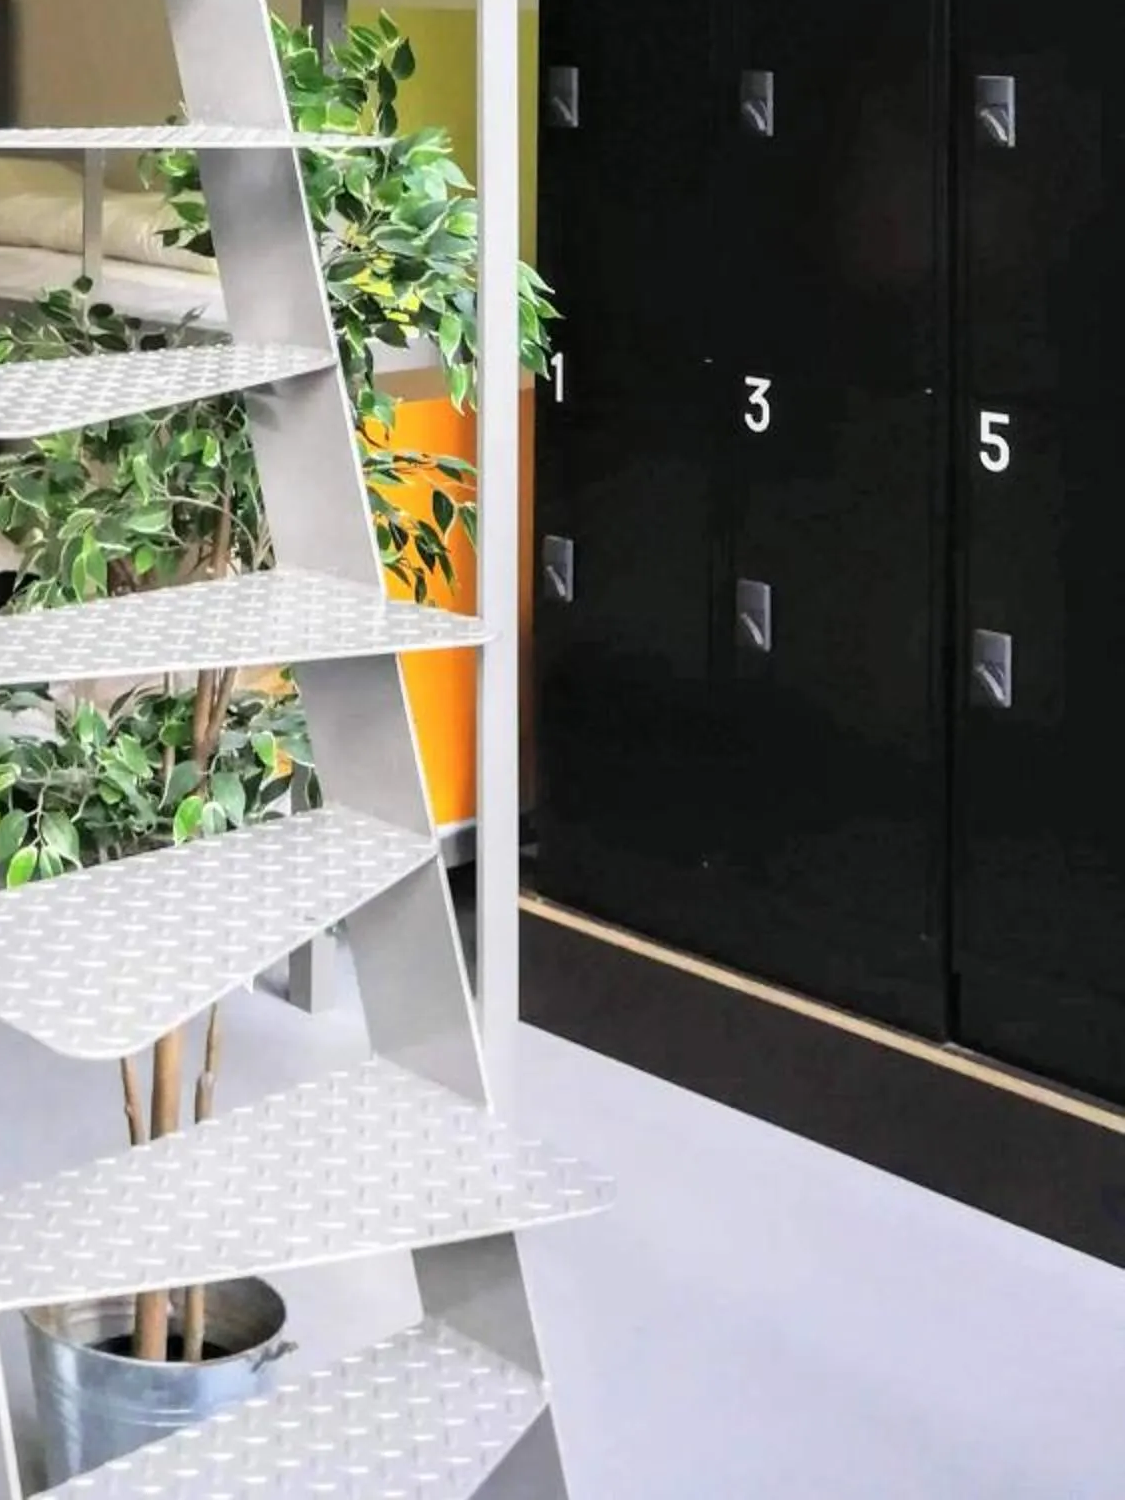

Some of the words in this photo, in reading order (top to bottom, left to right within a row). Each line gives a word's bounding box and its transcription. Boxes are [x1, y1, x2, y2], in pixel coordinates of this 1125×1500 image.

[550, 352, 564, 403] 1
[744, 376, 771, 434] 3
[979, 411, 1011, 473] 5
